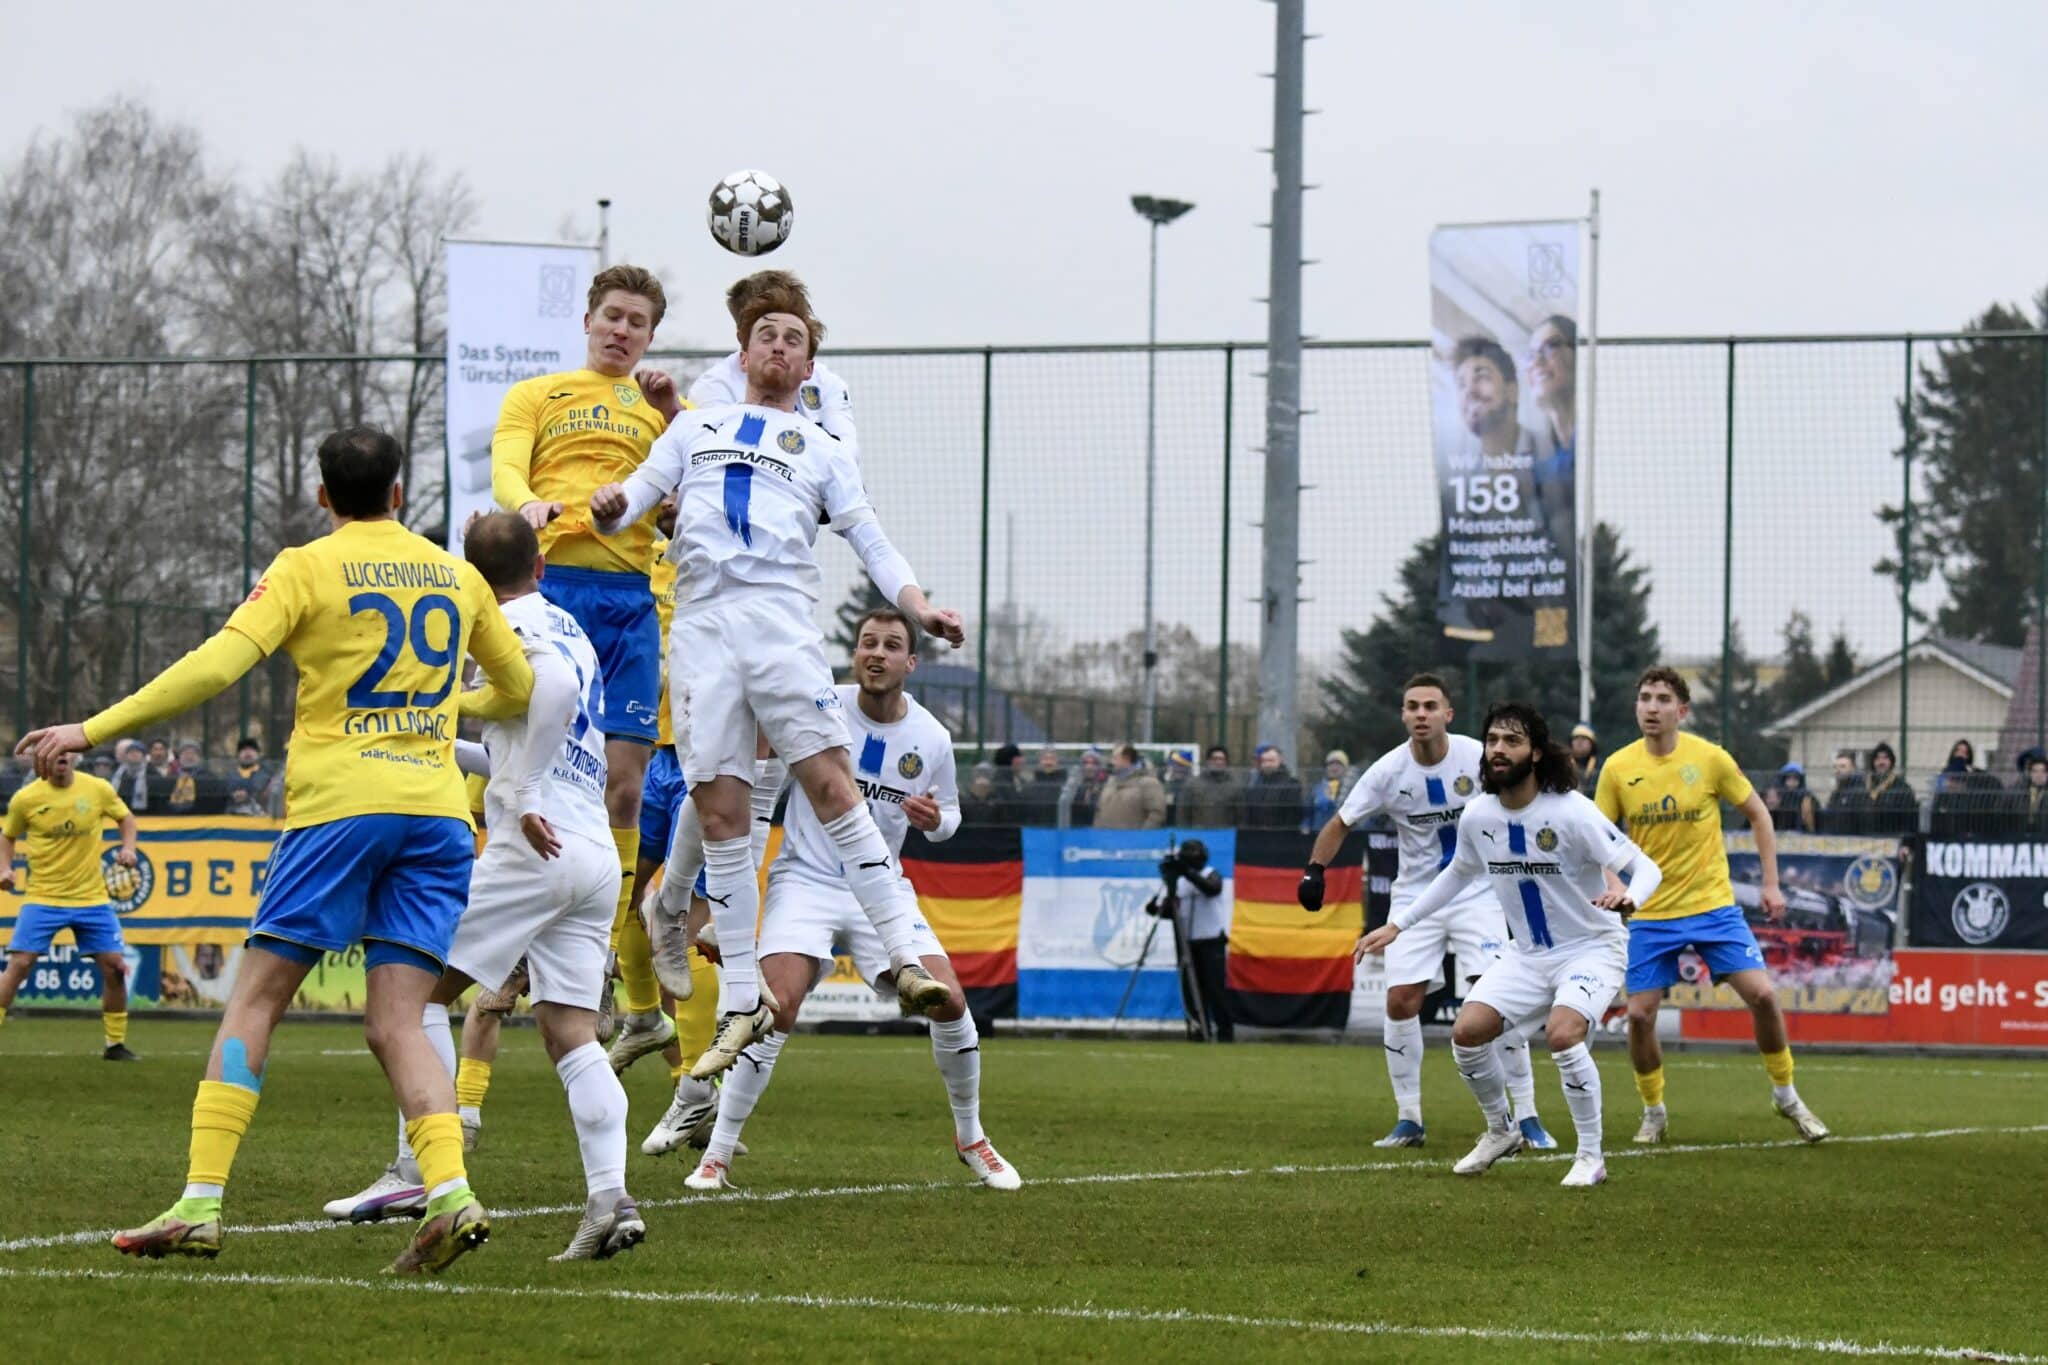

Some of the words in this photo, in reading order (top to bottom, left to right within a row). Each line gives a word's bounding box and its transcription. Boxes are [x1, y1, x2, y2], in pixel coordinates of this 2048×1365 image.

[494, 345, 560, 366] System
[569, 409, 589, 420] DIE
[1449, 474, 1520, 513] 158
[1449, 517, 1535, 534] Menschen
[343, 562, 461, 591] LUCKENWALDE
[1452, 560, 1502, 576] werde
[1507, 558, 1546, 576] auch
[1452, 579, 1499, 598] Azubi
[1503, 579, 1529, 597] bei
[347, 592, 461, 709] 29
[35, 969, 60, 990] 88
[68, 969, 94, 990] 66
[1939, 978, 2009, 1012] geht
